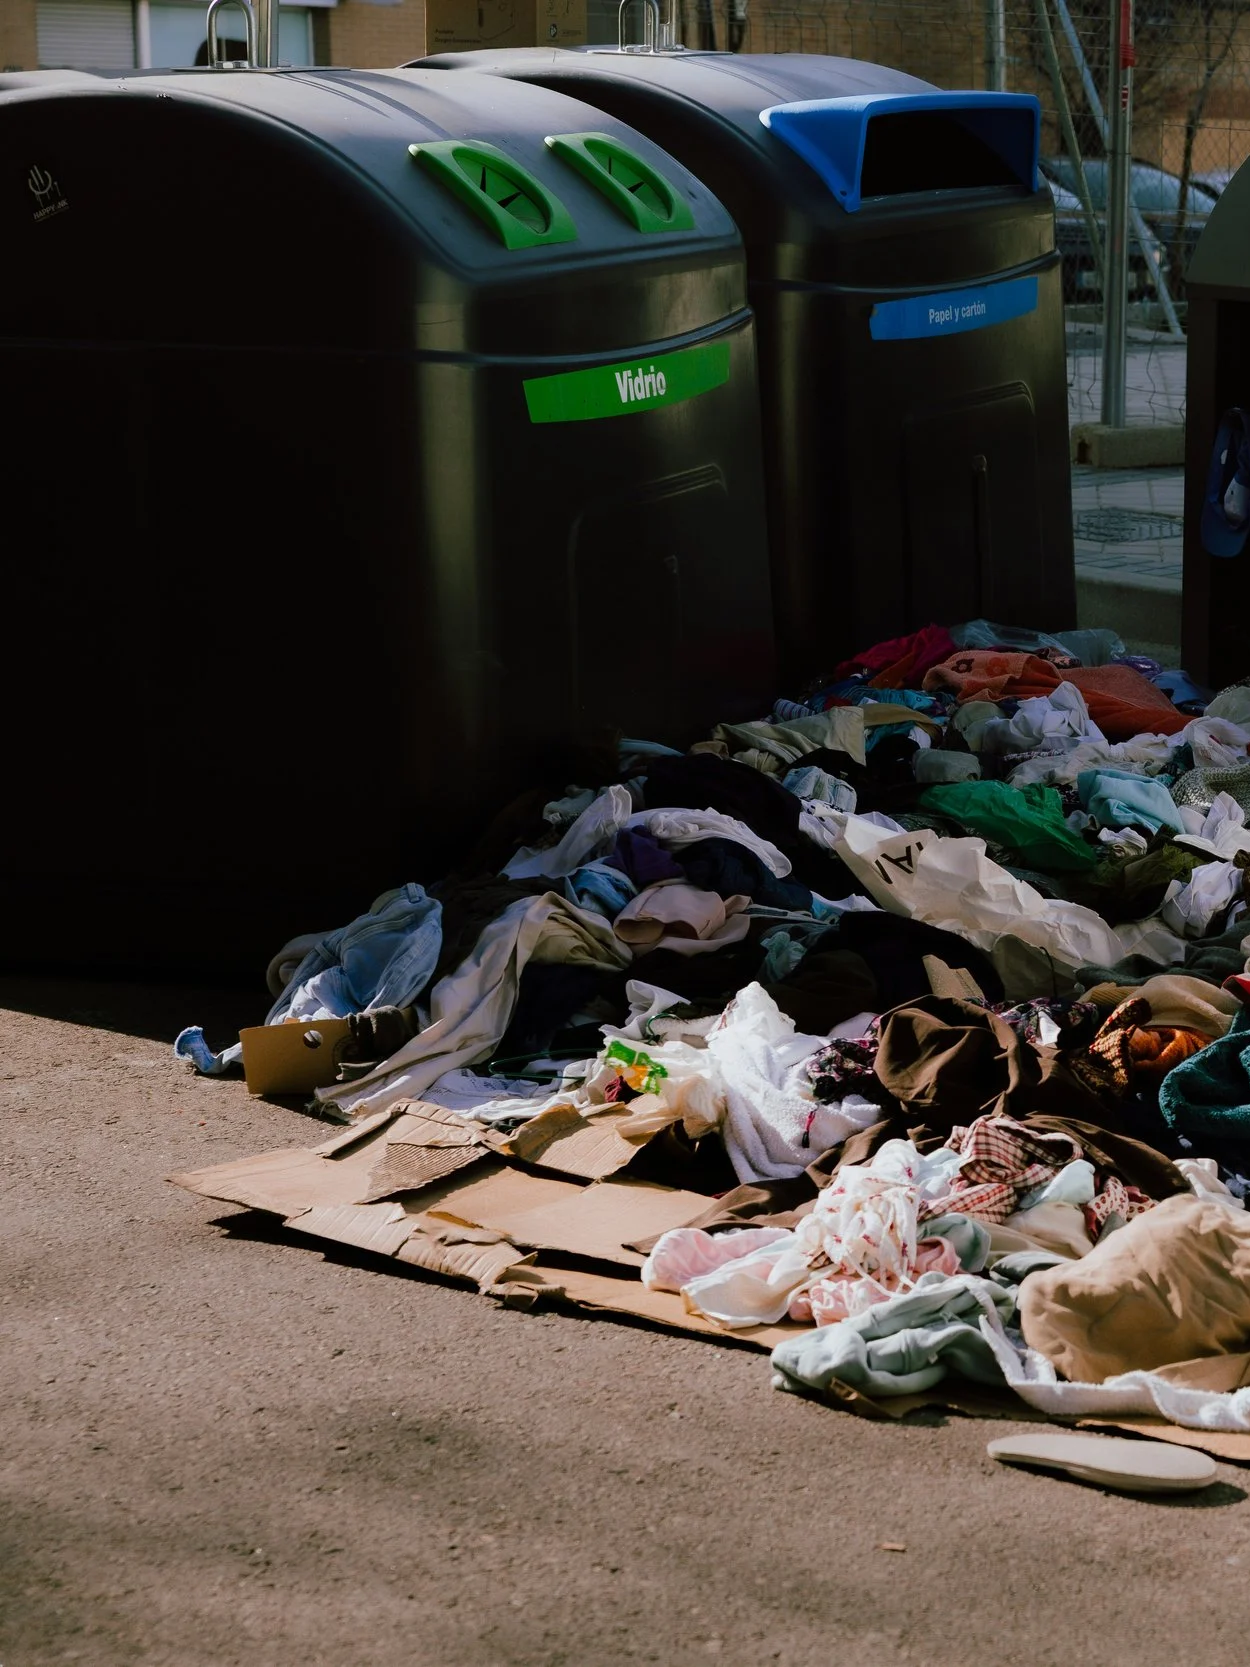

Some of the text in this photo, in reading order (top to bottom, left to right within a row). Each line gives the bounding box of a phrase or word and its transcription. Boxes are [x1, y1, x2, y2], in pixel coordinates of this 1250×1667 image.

[33, 204, 56, 220] HAPPY
[929, 300, 987, 326] Papel y cartón
[615, 365, 667, 404] Vidrio
